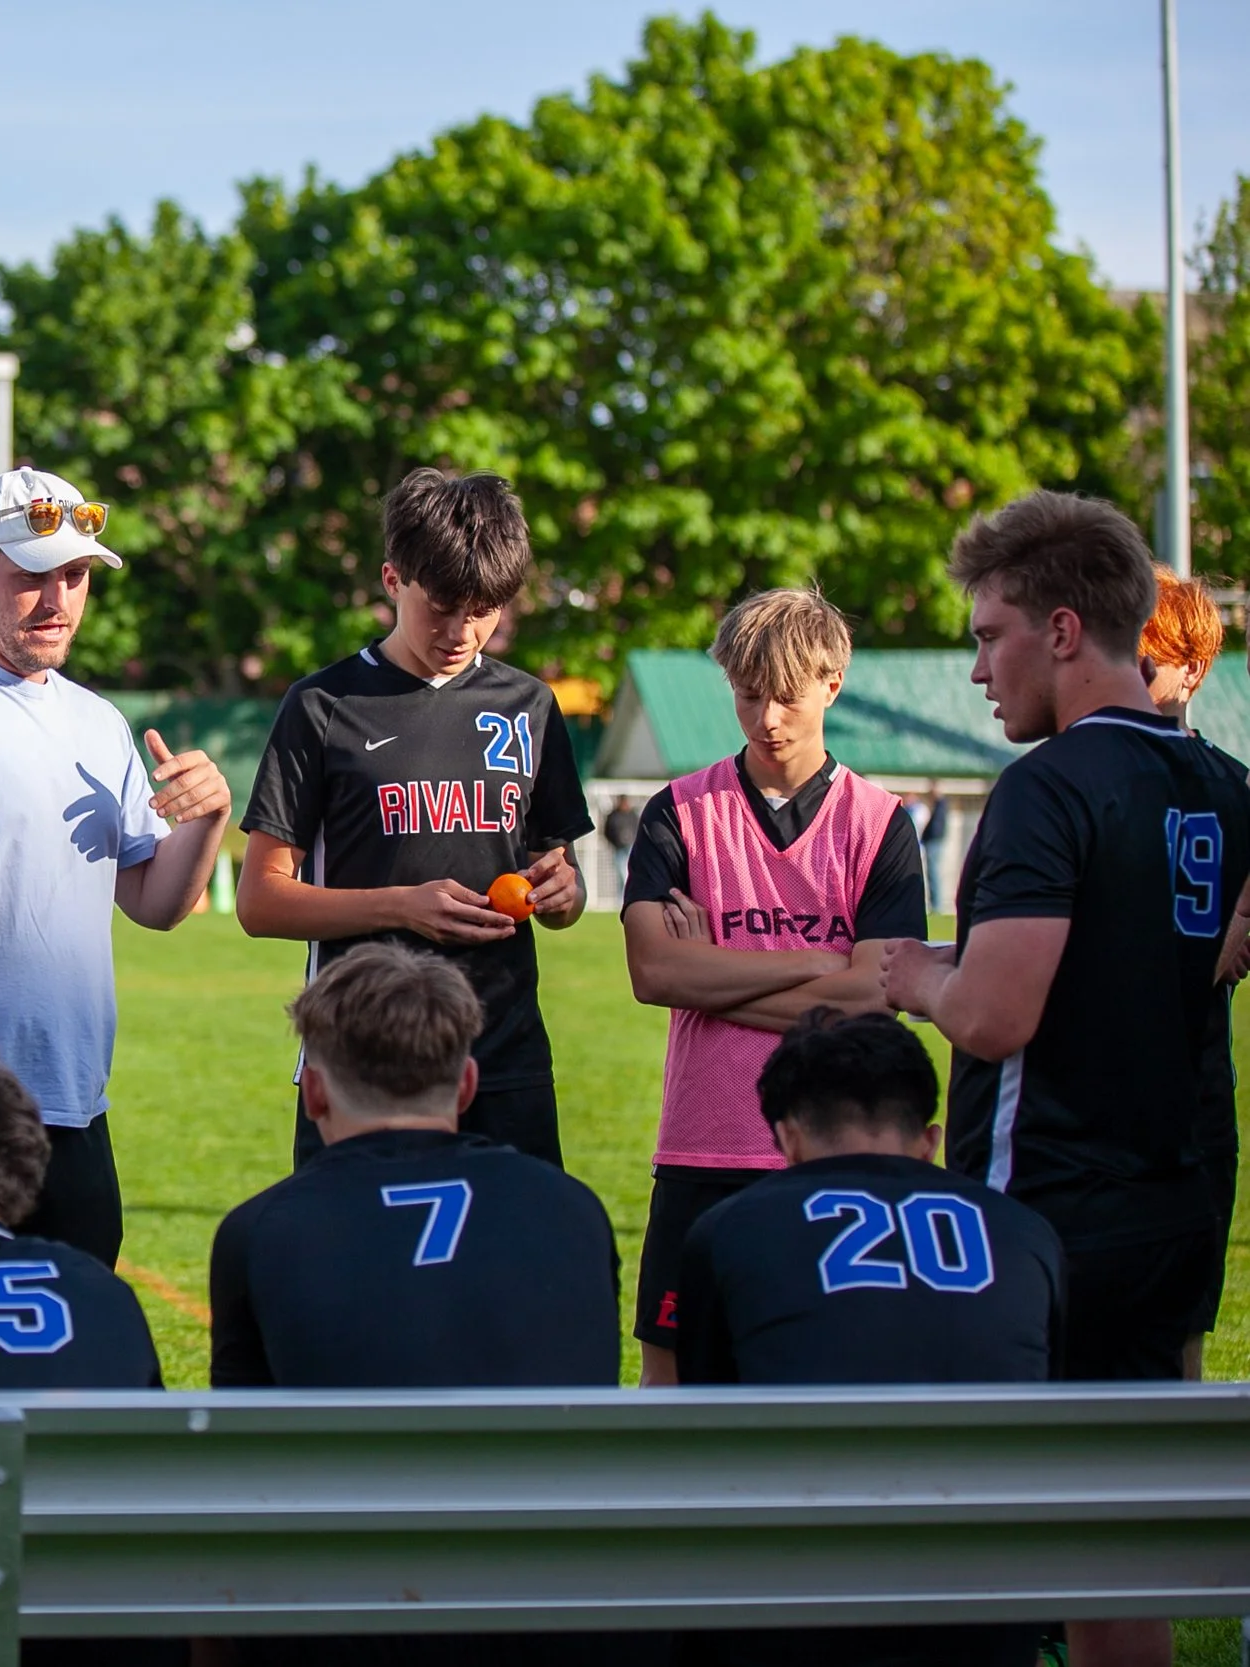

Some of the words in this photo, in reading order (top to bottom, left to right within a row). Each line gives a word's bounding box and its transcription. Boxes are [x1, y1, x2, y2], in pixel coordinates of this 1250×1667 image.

[475, 711, 533, 779] 21
[377, 779, 522, 836] RIVALS
[721, 906, 854, 943] FORZA
[380, 1178, 473, 1267] 7
[803, 1188, 995, 1295] 20
